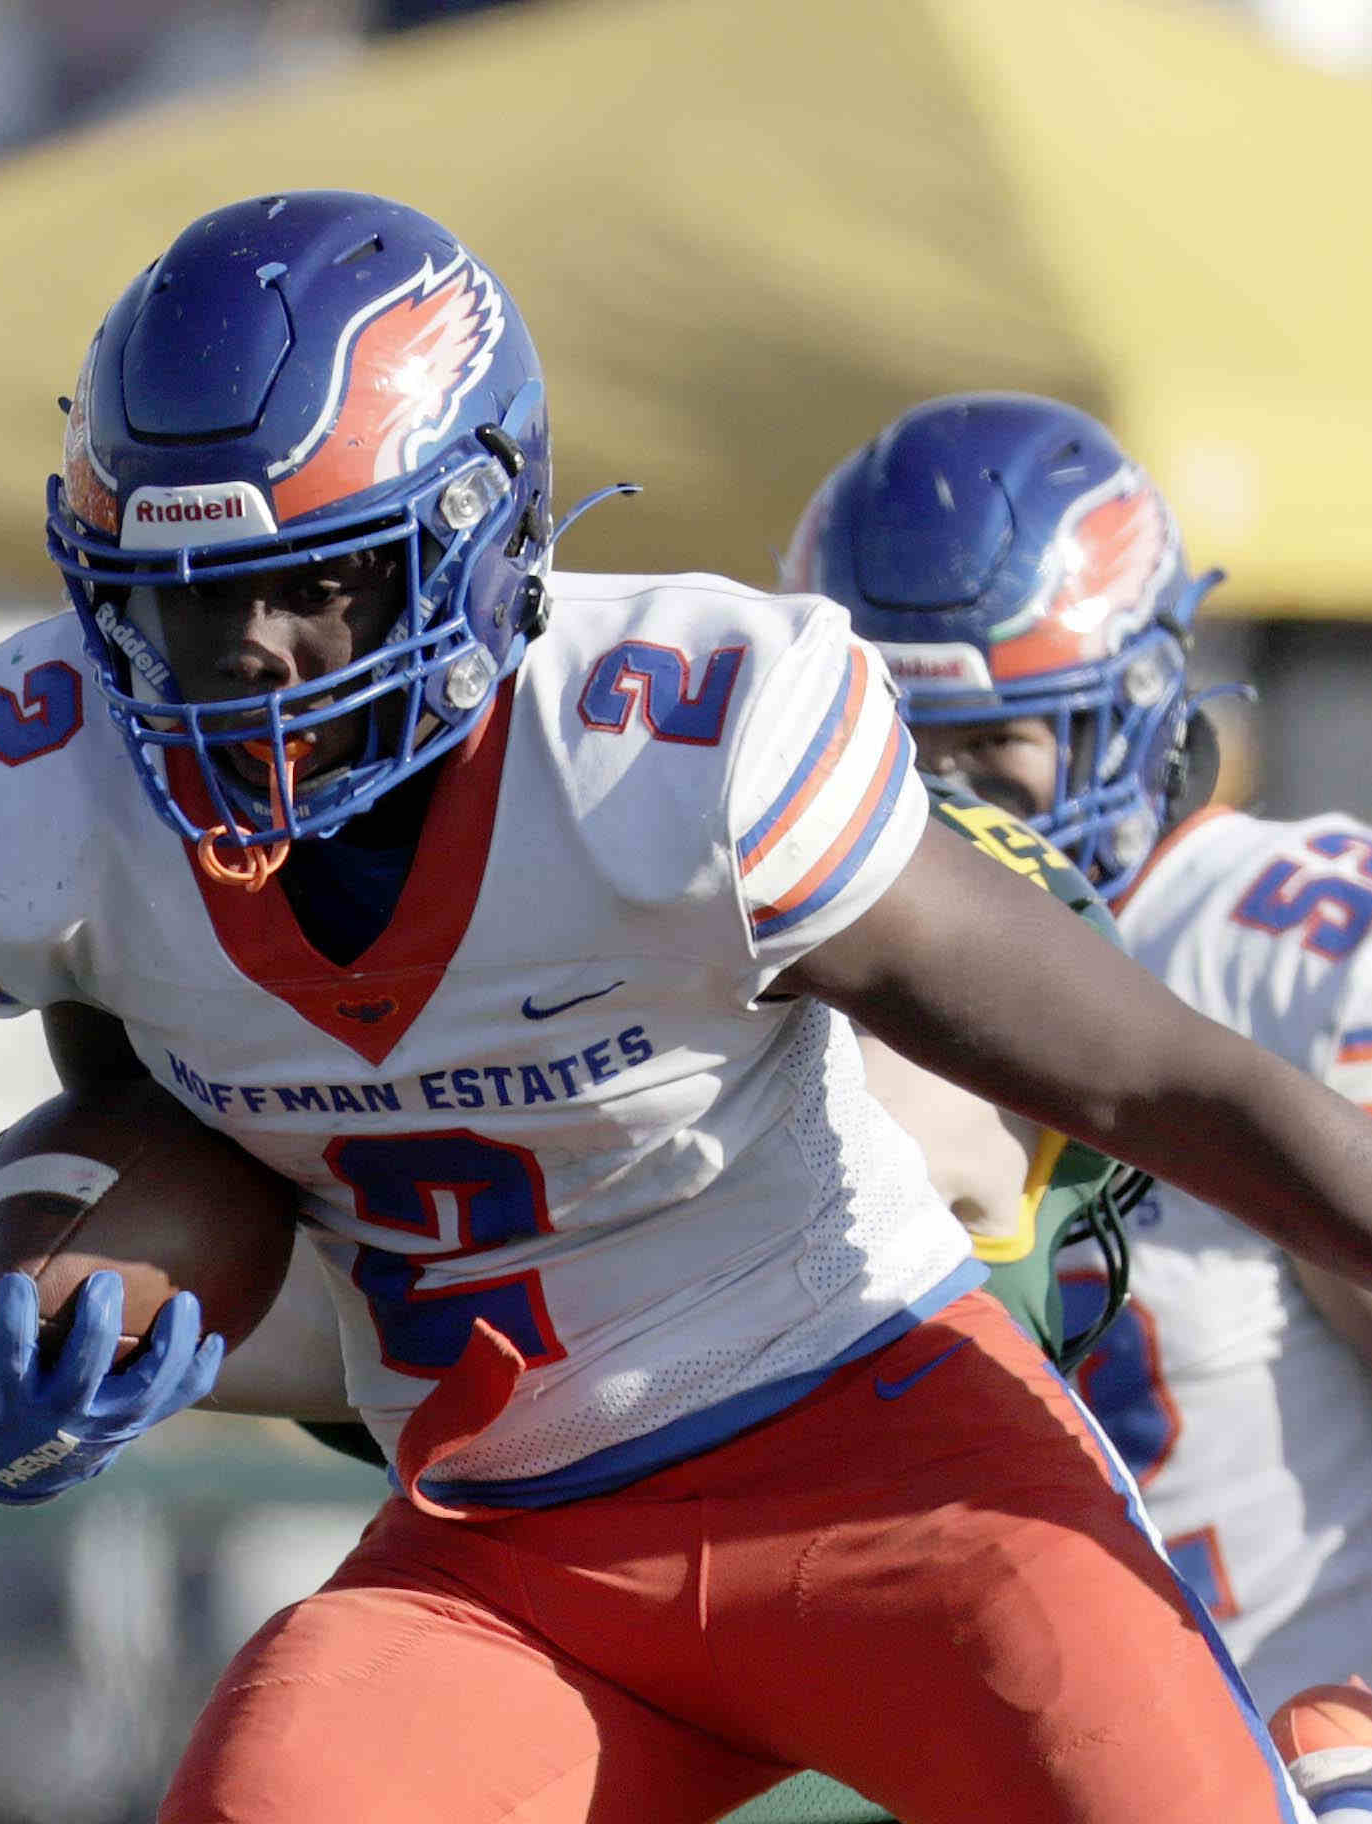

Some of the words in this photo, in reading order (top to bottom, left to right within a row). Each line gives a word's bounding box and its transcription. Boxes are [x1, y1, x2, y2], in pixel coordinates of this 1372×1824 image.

[135, 497, 244, 523] Riddell
[95, 602, 170, 687] Riddell
[577, 639, 747, 747] 2
[164, 1048, 401, 1114] HOFFMAN
[419, 1024, 654, 1111] ESTATES
[325, 1127, 568, 1382] 2
